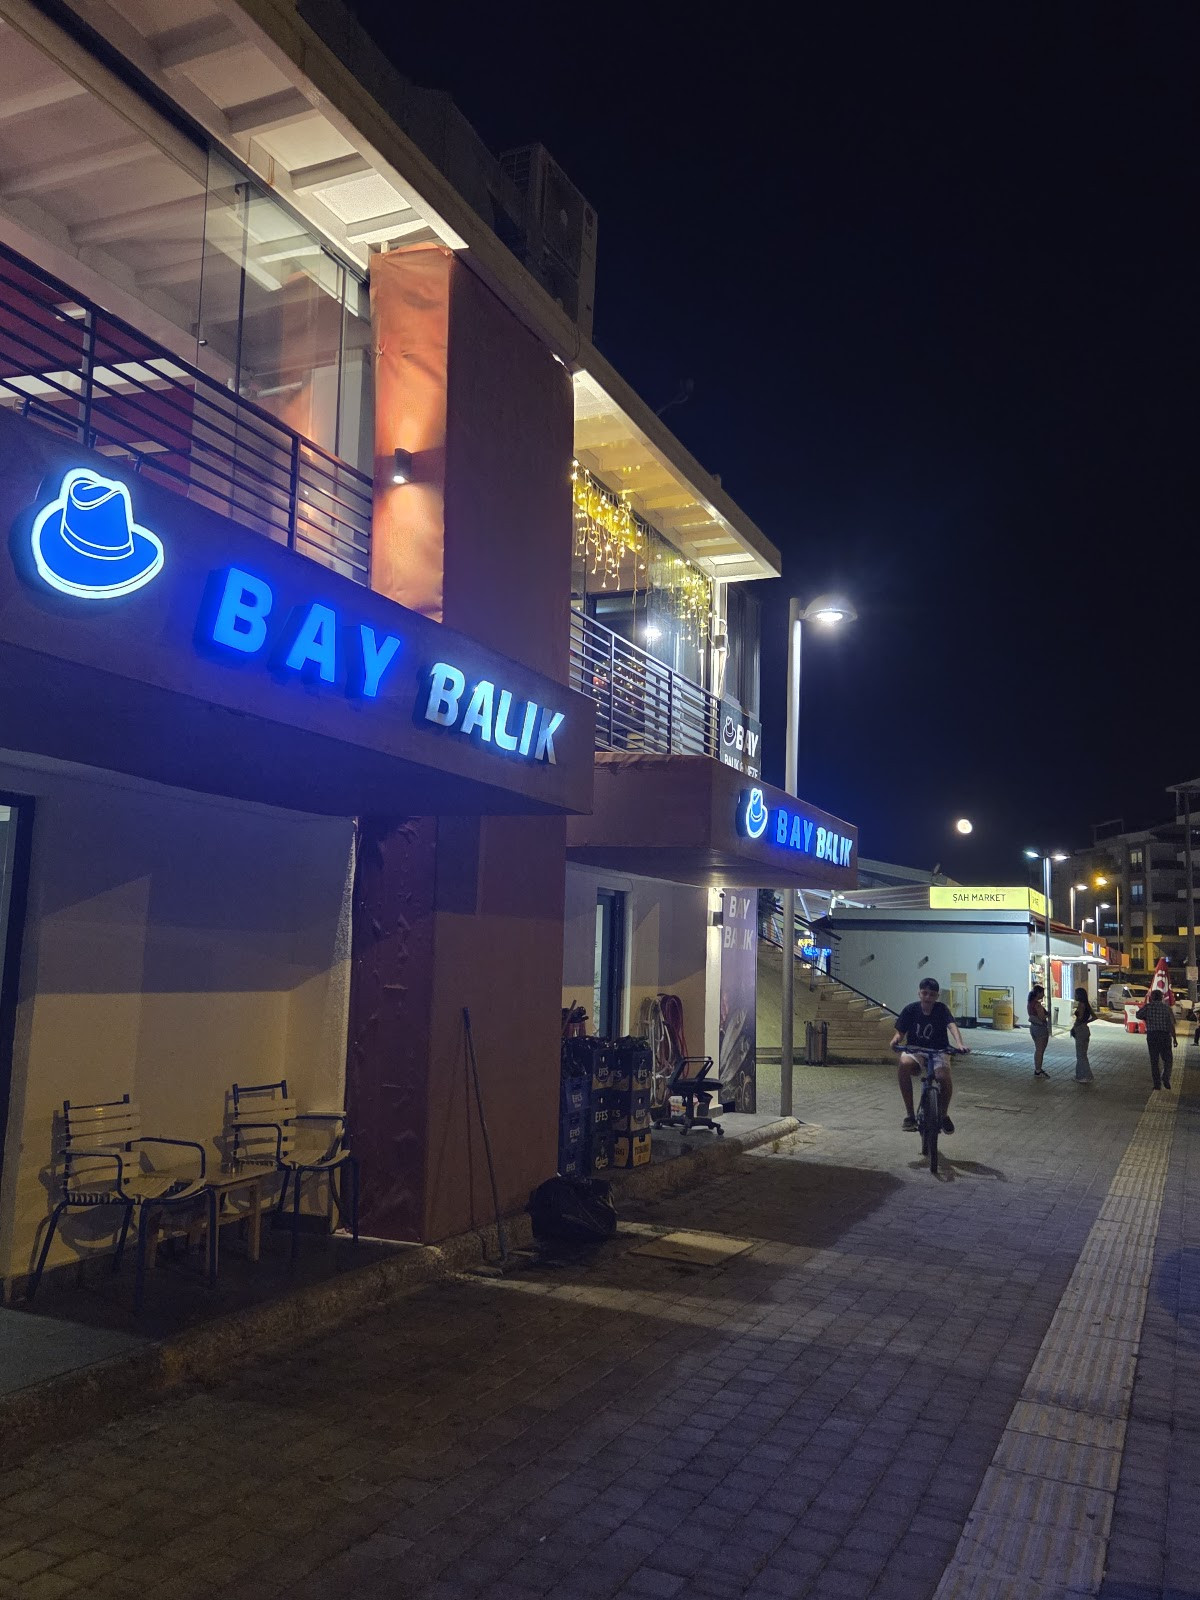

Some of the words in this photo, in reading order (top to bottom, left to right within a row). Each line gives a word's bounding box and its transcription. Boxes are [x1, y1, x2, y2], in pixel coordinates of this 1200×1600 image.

[211, 567, 402, 698] BAY
[423, 662, 565, 765] BALIK
[735, 723, 759, 758] BAY
[776, 809, 813, 853] BAY
[815, 826, 853, 868] BALIK
[728, 895, 751, 920] BAY
[952, 893, 969, 904] ŞAH
[971, 893, 1006, 902] MARKET
[723, 925, 754, 951] BAIK
[595, 1109, 608, 1123] EFES
